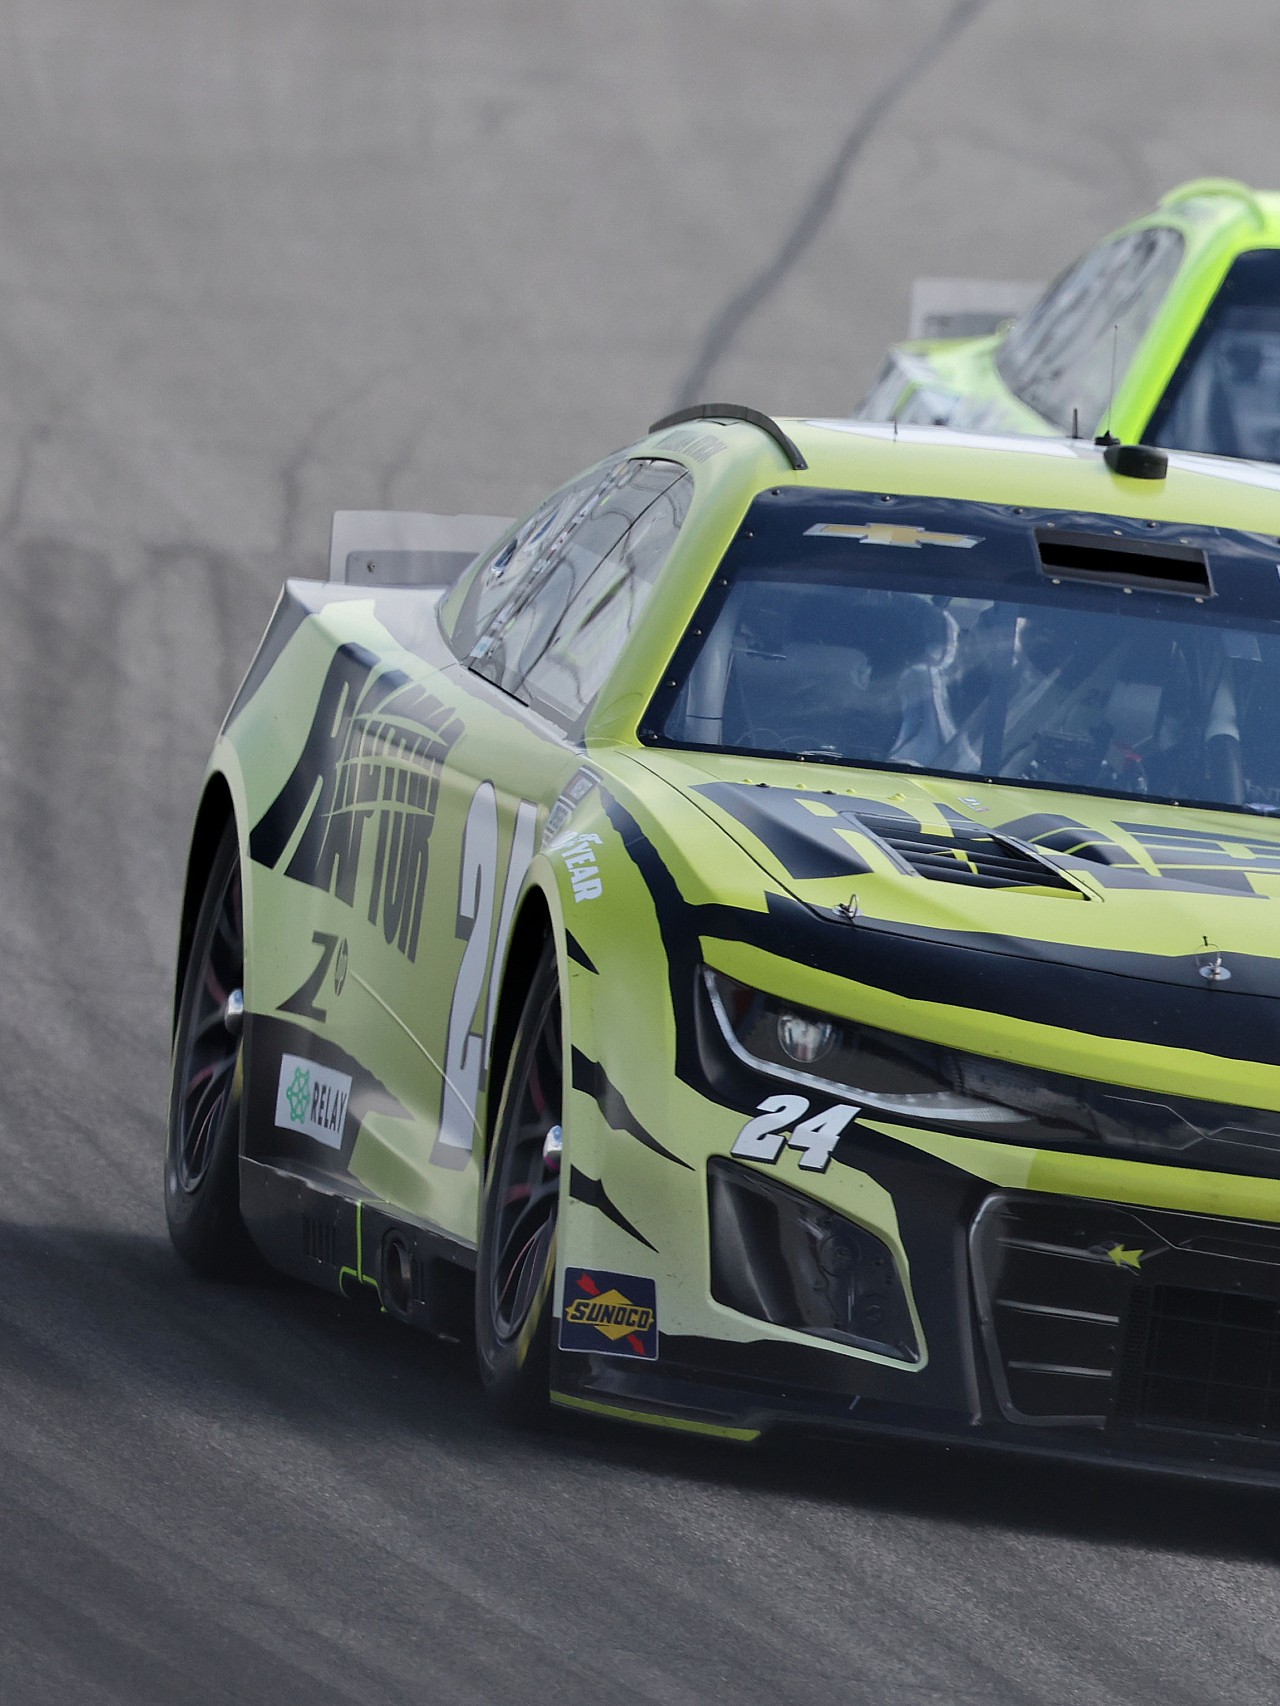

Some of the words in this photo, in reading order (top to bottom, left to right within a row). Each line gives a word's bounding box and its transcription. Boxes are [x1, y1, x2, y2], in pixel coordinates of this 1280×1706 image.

[310, 1081, 347, 1133] RELAY
[730, 1093, 862, 1173] 24
[570, 1301, 651, 1329] SUNOCO
